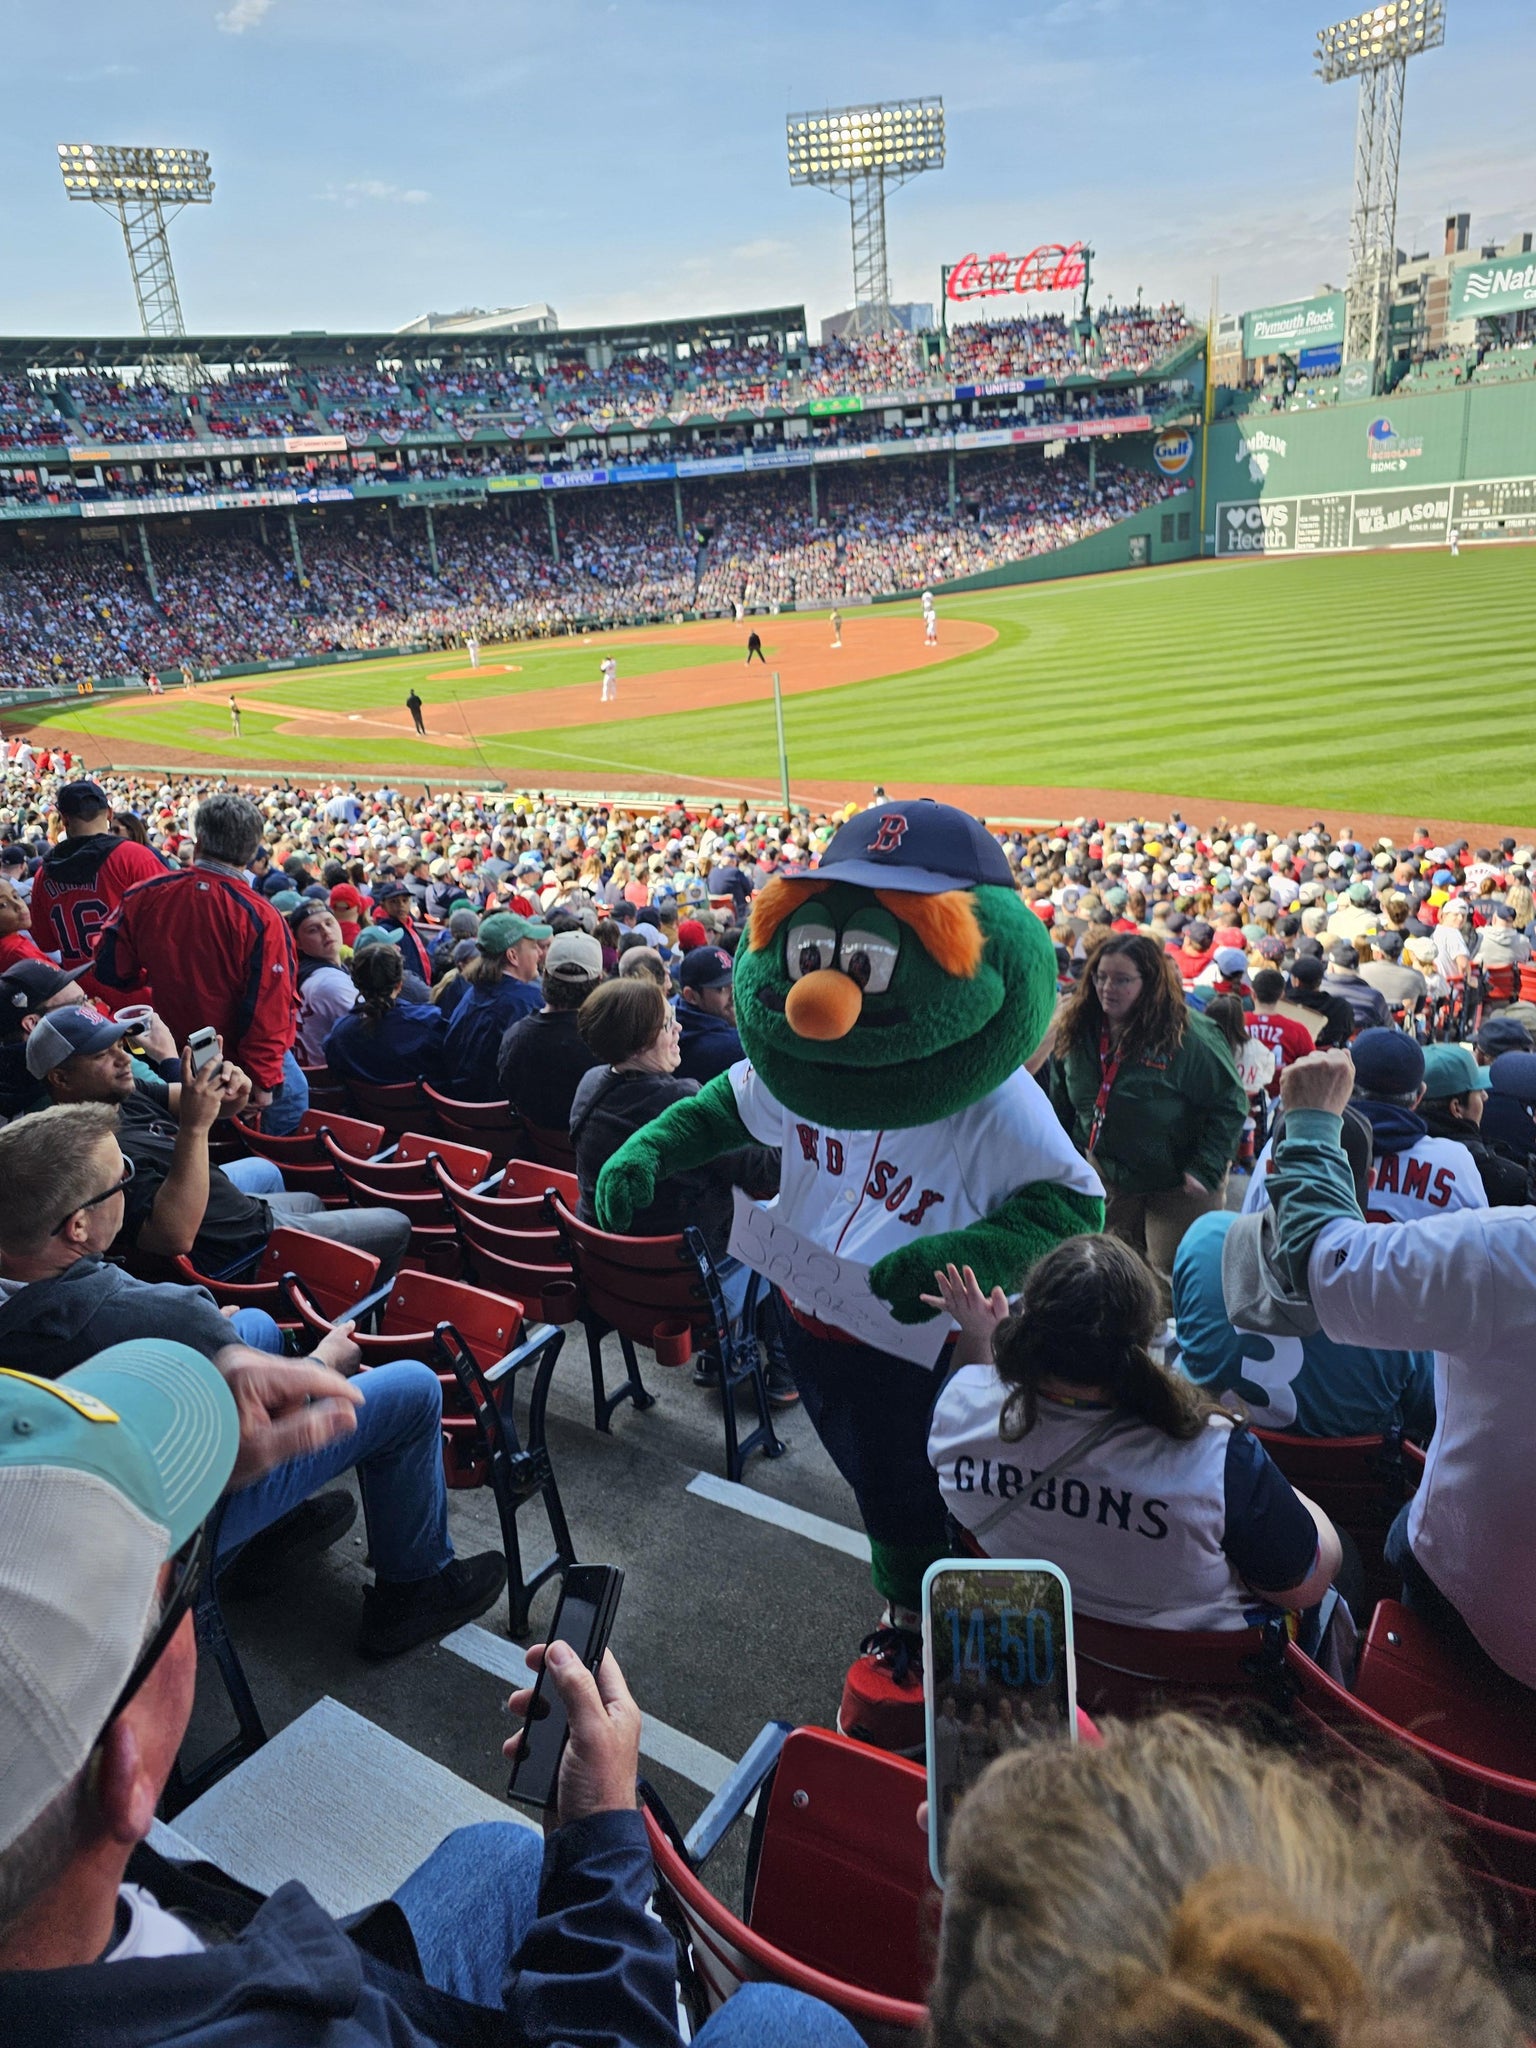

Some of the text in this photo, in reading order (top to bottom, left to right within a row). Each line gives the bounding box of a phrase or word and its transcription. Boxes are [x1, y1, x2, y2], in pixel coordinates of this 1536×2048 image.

[947, 240, 1086, 302] Coca-Cola
[1253, 314, 1305, 337] Plymouth
[1306, 306, 1335, 327] Rock
[985, 381, 1026, 396] UNITED
[1155, 441, 1188, 458] Gulf
[1256, 430, 1287, 458] BEAM
[1246, 504, 1289, 529] CVS
[1227, 526, 1288, 551] Health
[867, 814, 909, 852] B
[50, 898, 110, 960] 16
[865, 1160, 945, 1226] SOX
[954, 1455, 1170, 1540] GIBBONS
[944, 1607, 1056, 1687] 14:50
